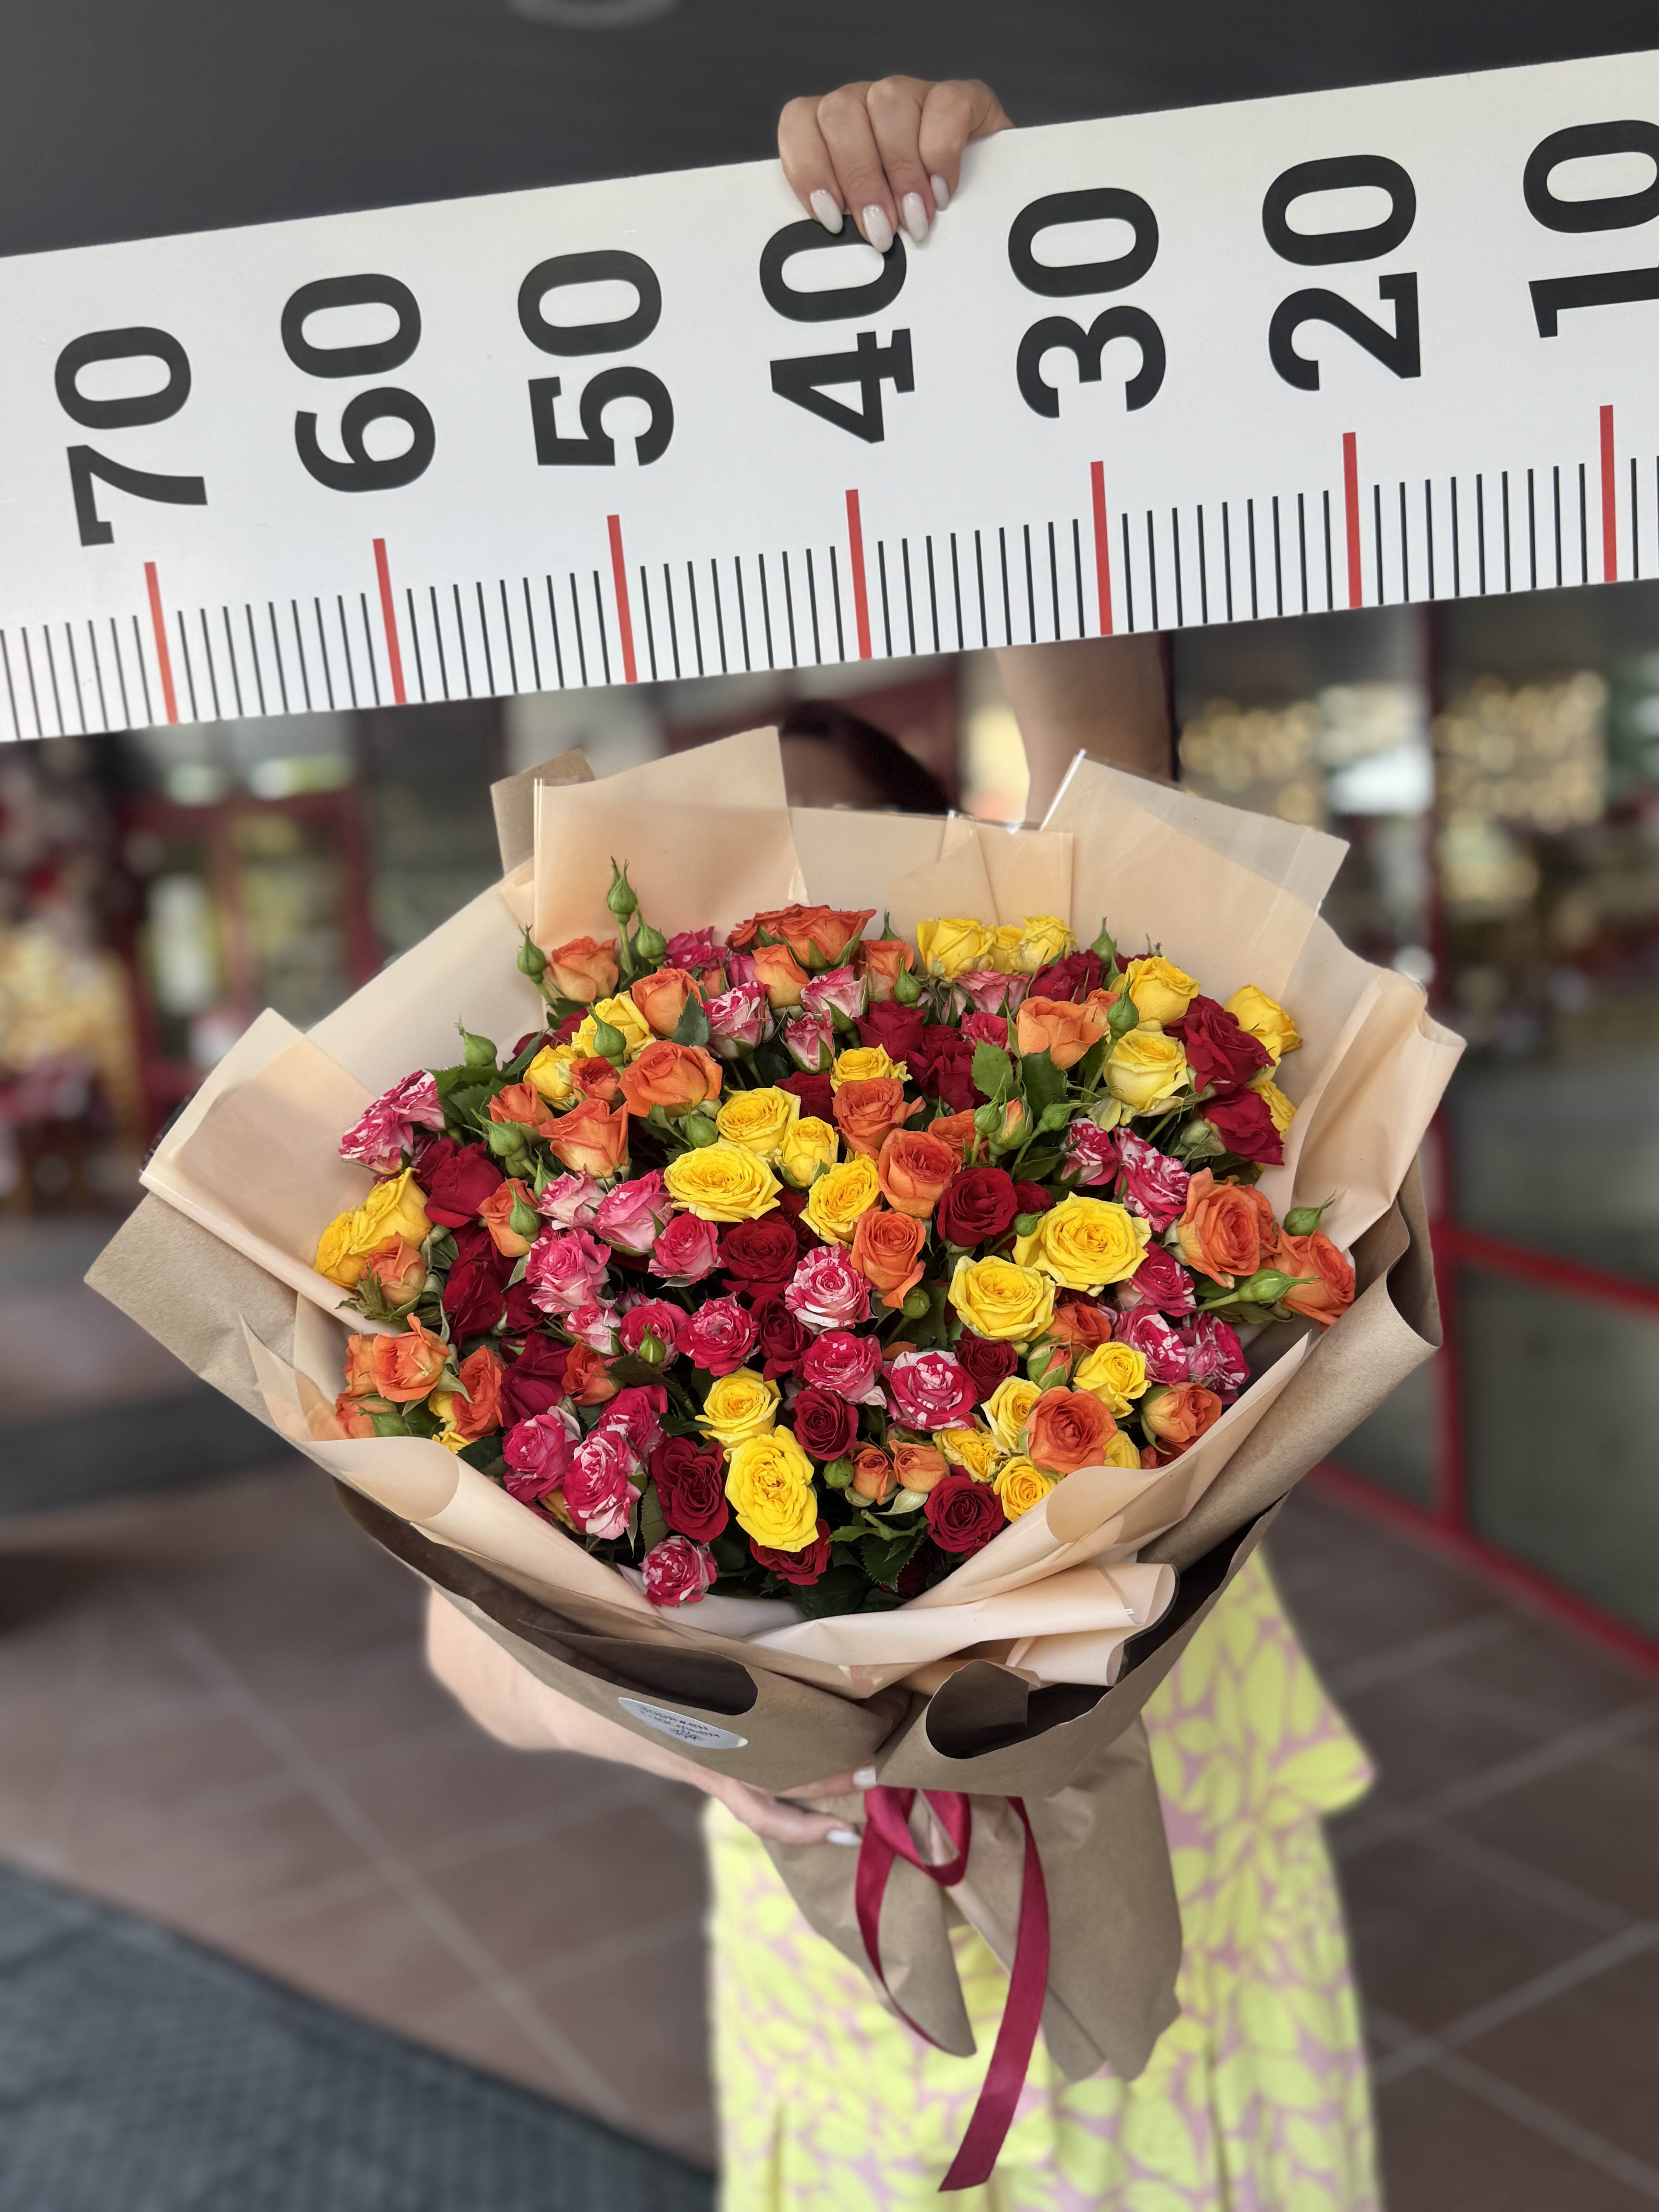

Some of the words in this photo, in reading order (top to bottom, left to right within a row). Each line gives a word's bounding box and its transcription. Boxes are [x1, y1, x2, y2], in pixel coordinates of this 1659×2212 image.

[759, 214, 915, 444] 40
[1008, 187, 1166, 418] 30
[1262, 155, 1421, 391] 20
[1523, 120, 1659, 338] 10
[55, 327, 208, 546] 70
[281, 274, 435, 492] 60
[518, 250, 674, 465] 50
